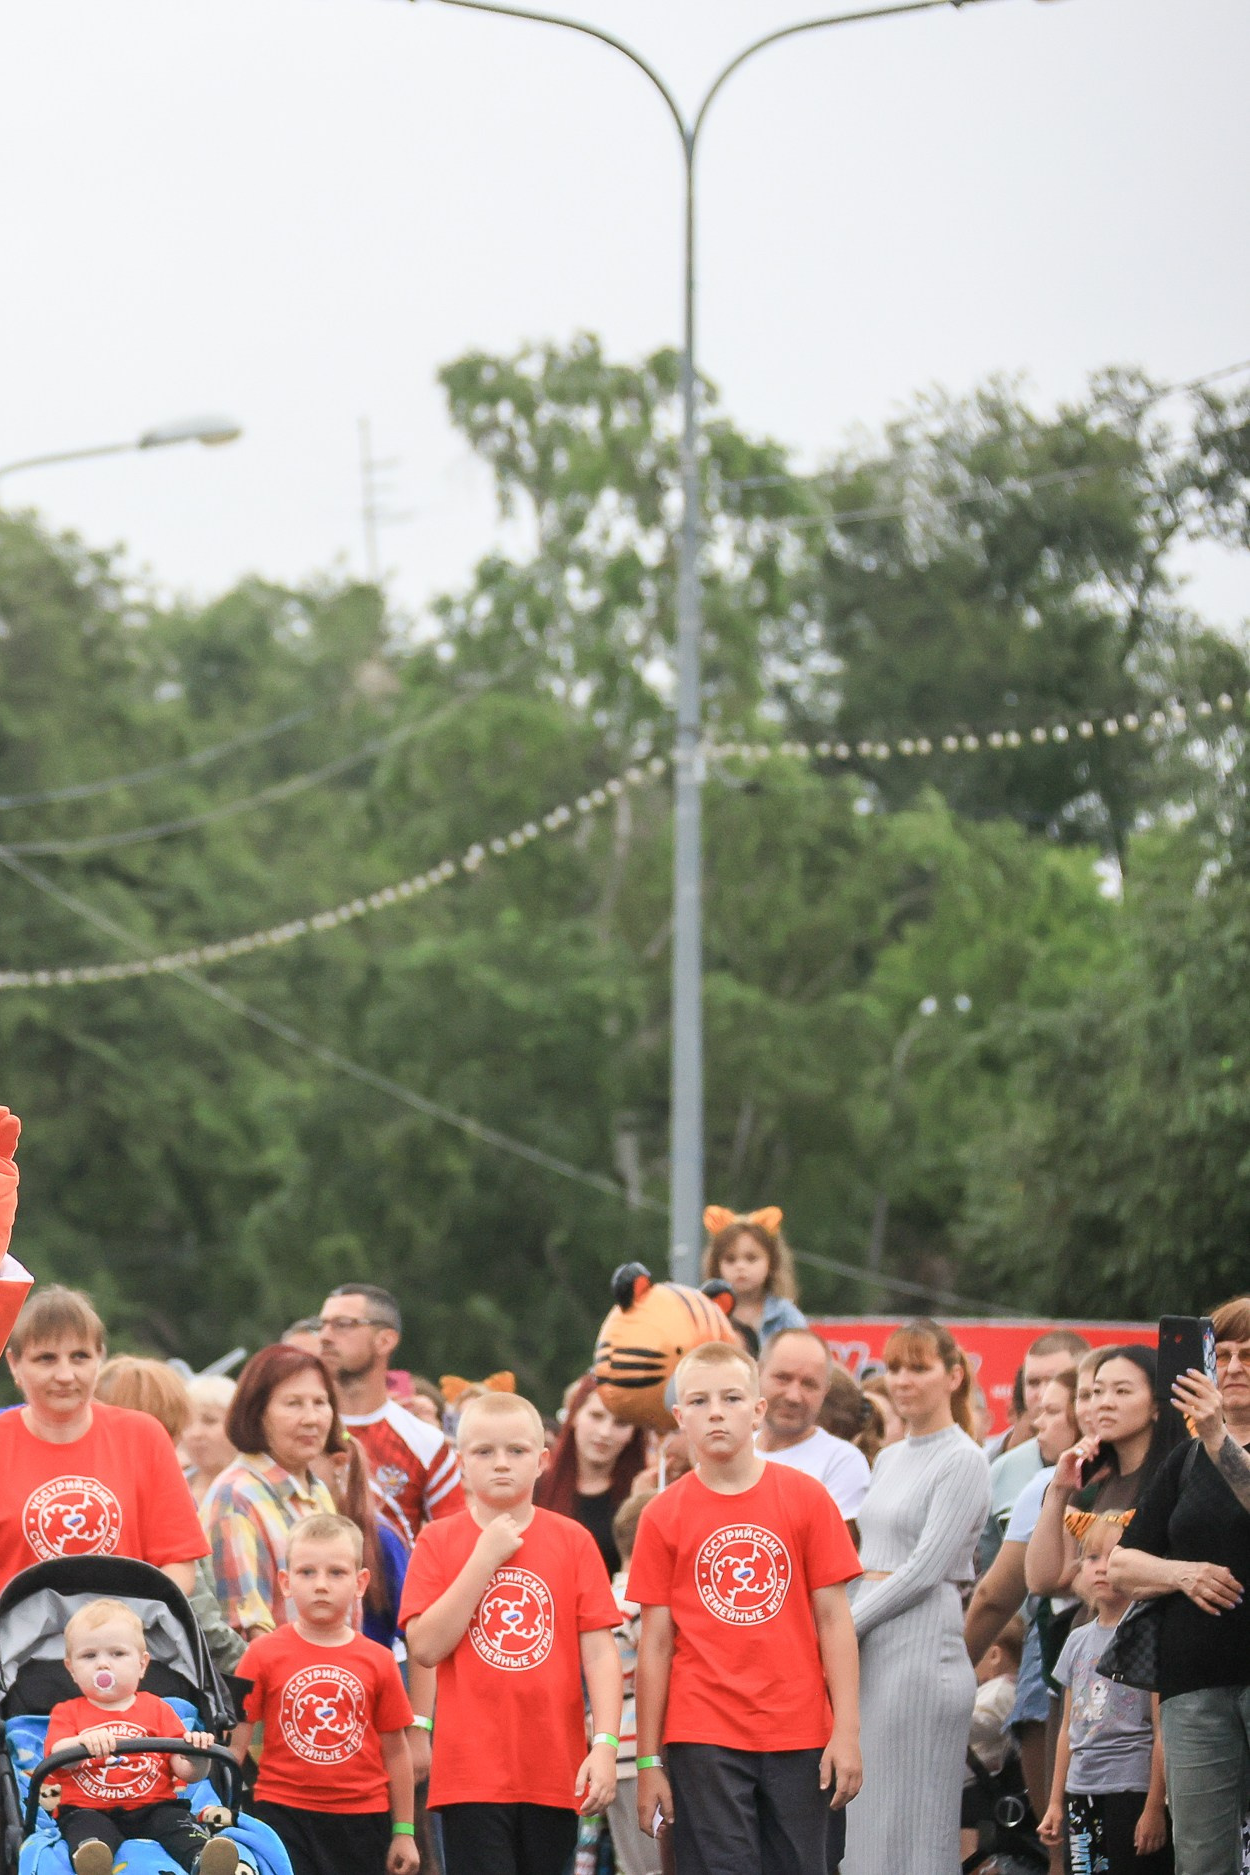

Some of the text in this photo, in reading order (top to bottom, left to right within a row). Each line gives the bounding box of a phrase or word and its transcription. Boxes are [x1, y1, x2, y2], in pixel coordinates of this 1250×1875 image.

[29, 1479, 114, 1511] УССУРИЙСКИЕ
[700, 1527, 783, 1565] УССУРИЙСКИЕ
[485, 1570, 549, 1606] УРИЙСКИЕ
[702, 1578, 787, 1623] СЕМЕЙНЫЕ ИГРЫ
[471, 1626, 552, 1667] СЕМЕЙНЫЕ ИГРЫ
[285, 1669, 363, 1702] УССУРИЙСКИЕ
[284, 1721, 364, 1761] СЕМЕЙНЫЕ ИГРЫ
[76, 1772, 137, 1799] ЕМЕЙНЫЕ
